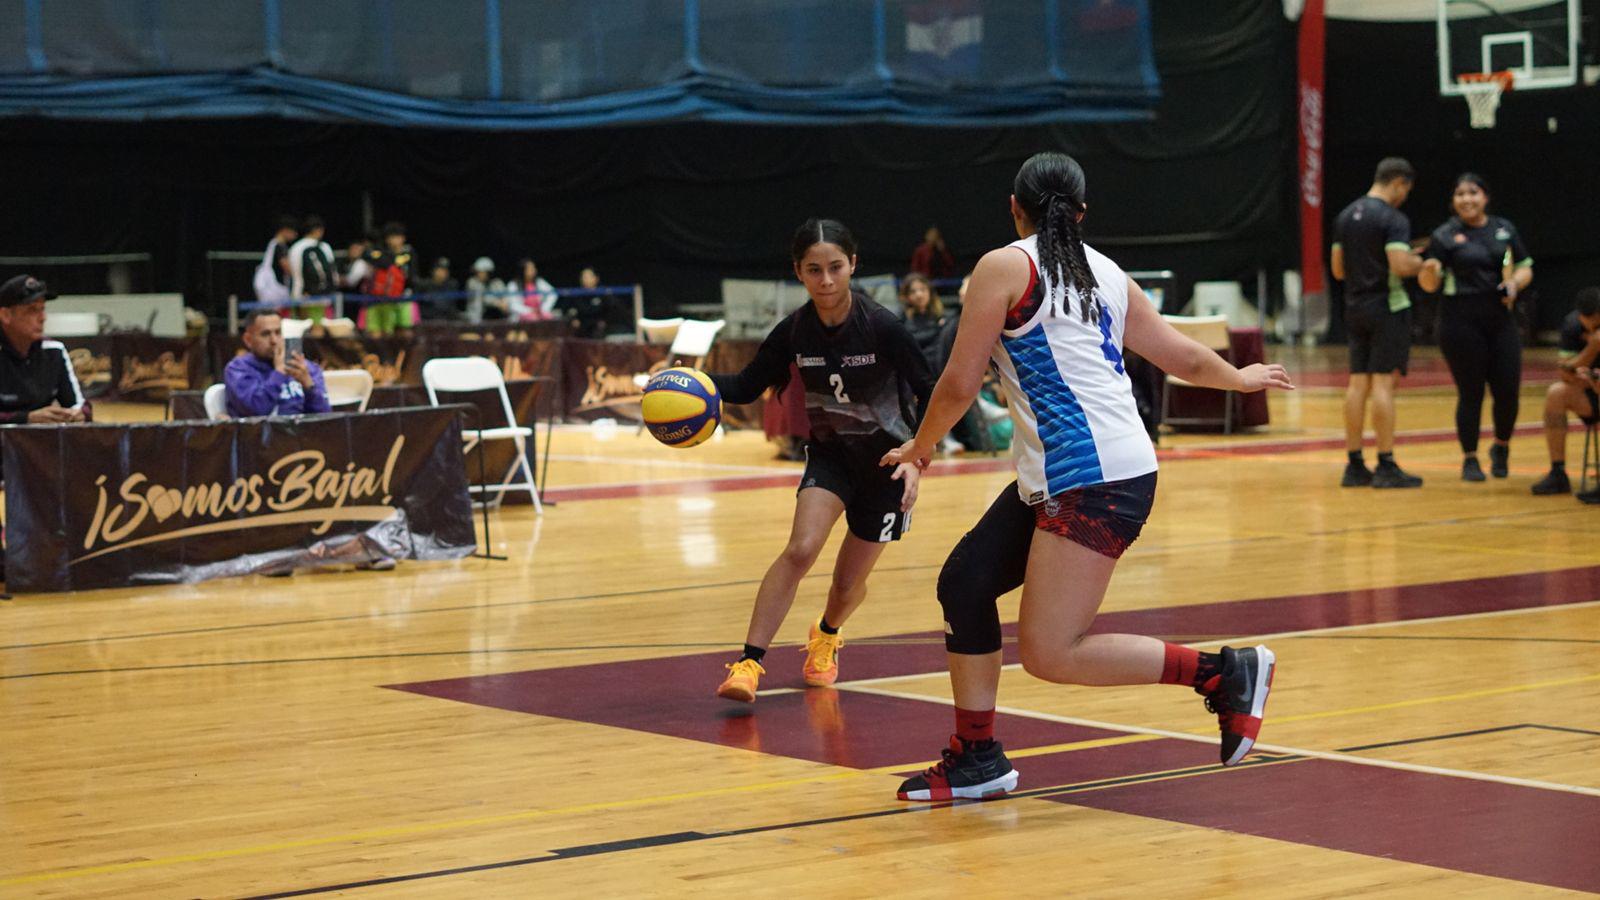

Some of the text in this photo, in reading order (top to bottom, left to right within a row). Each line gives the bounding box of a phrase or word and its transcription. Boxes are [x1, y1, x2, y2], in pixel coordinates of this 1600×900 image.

[829, 373, 851, 404] 2
[84, 435, 405, 549] ¡Somos Baja!
[879, 512, 896, 542] 2
